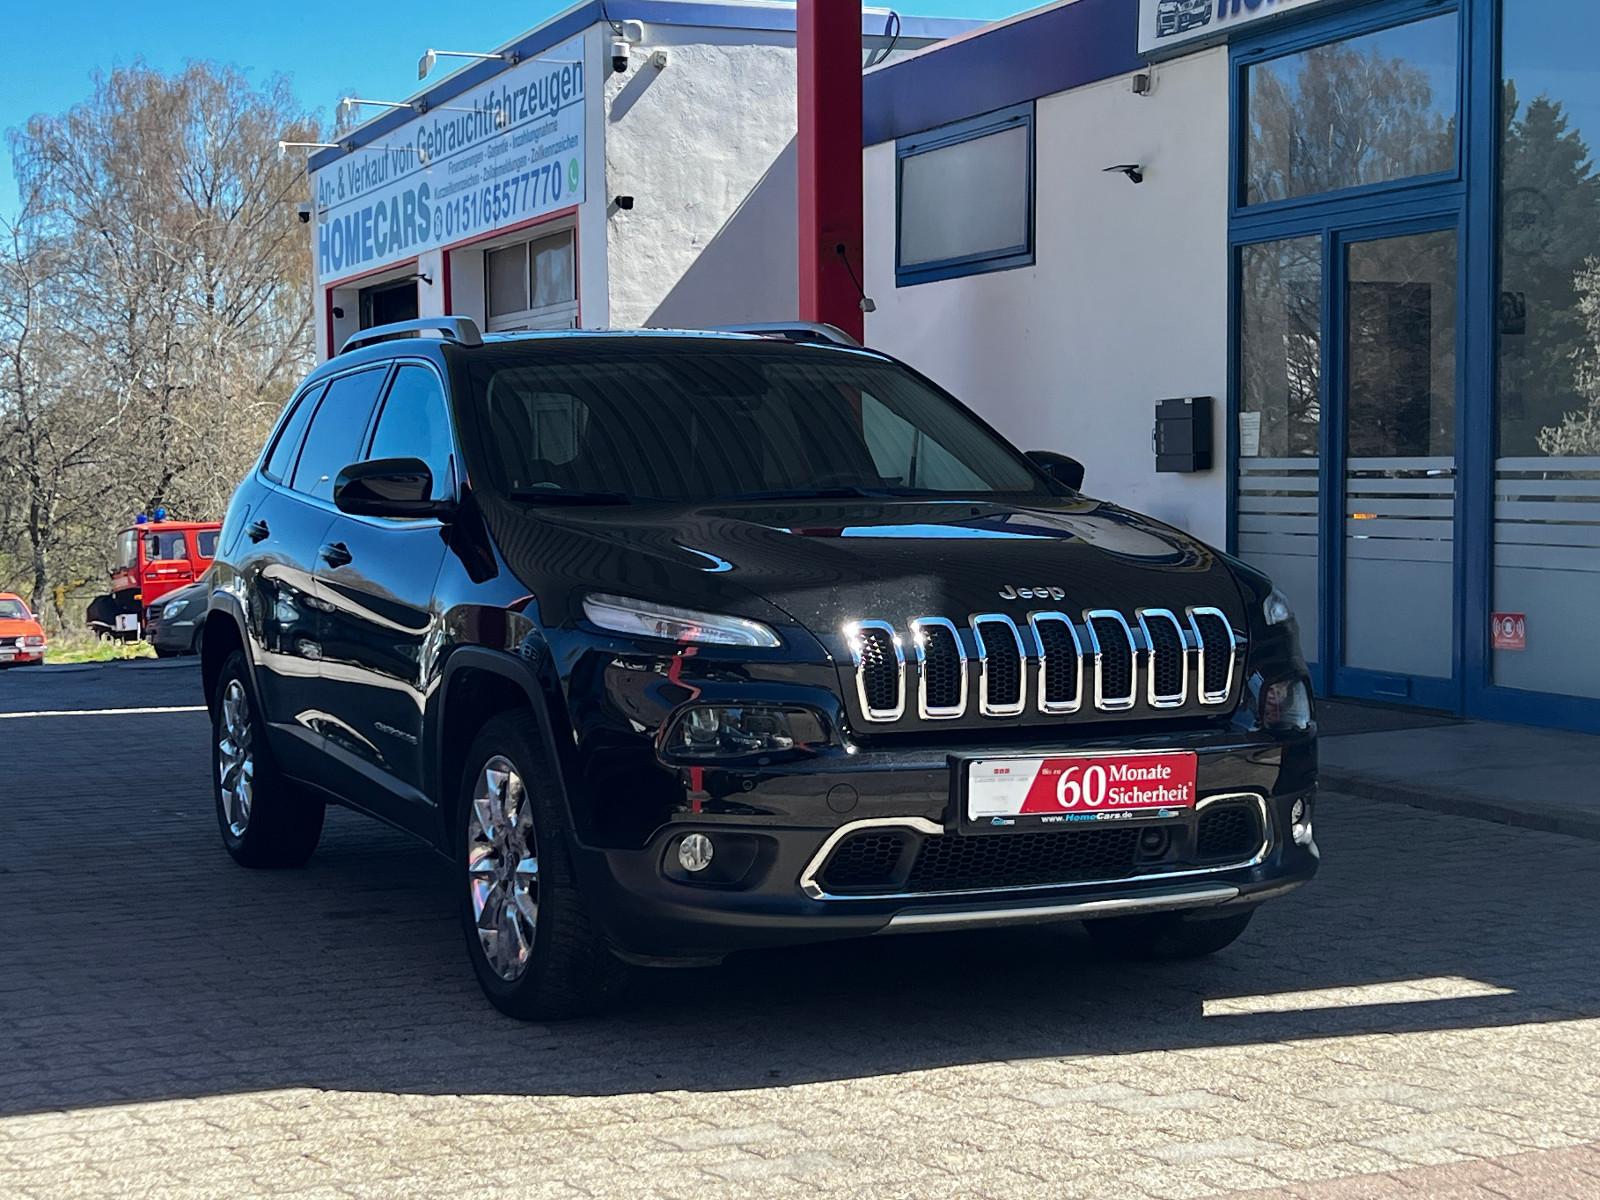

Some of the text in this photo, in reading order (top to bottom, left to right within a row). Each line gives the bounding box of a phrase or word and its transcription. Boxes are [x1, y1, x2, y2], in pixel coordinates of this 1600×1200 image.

[318, 61, 584, 208] An- & Verkauf von Gebrauchtfahrzeugen
[531, 134, 579, 164] Zollkennzeichen
[445, 161, 562, 237] 0151/65577770
[318, 181, 431, 275] HOMECARS
[998, 584, 1066, 601] Jeep
[1056, 765, 1107, 808] 60
[1108, 763, 1172, 782] Monate
[1108, 783, 1189, 805] Sicherheit
[1041, 811, 1133, 823] www.HomeCars.de
